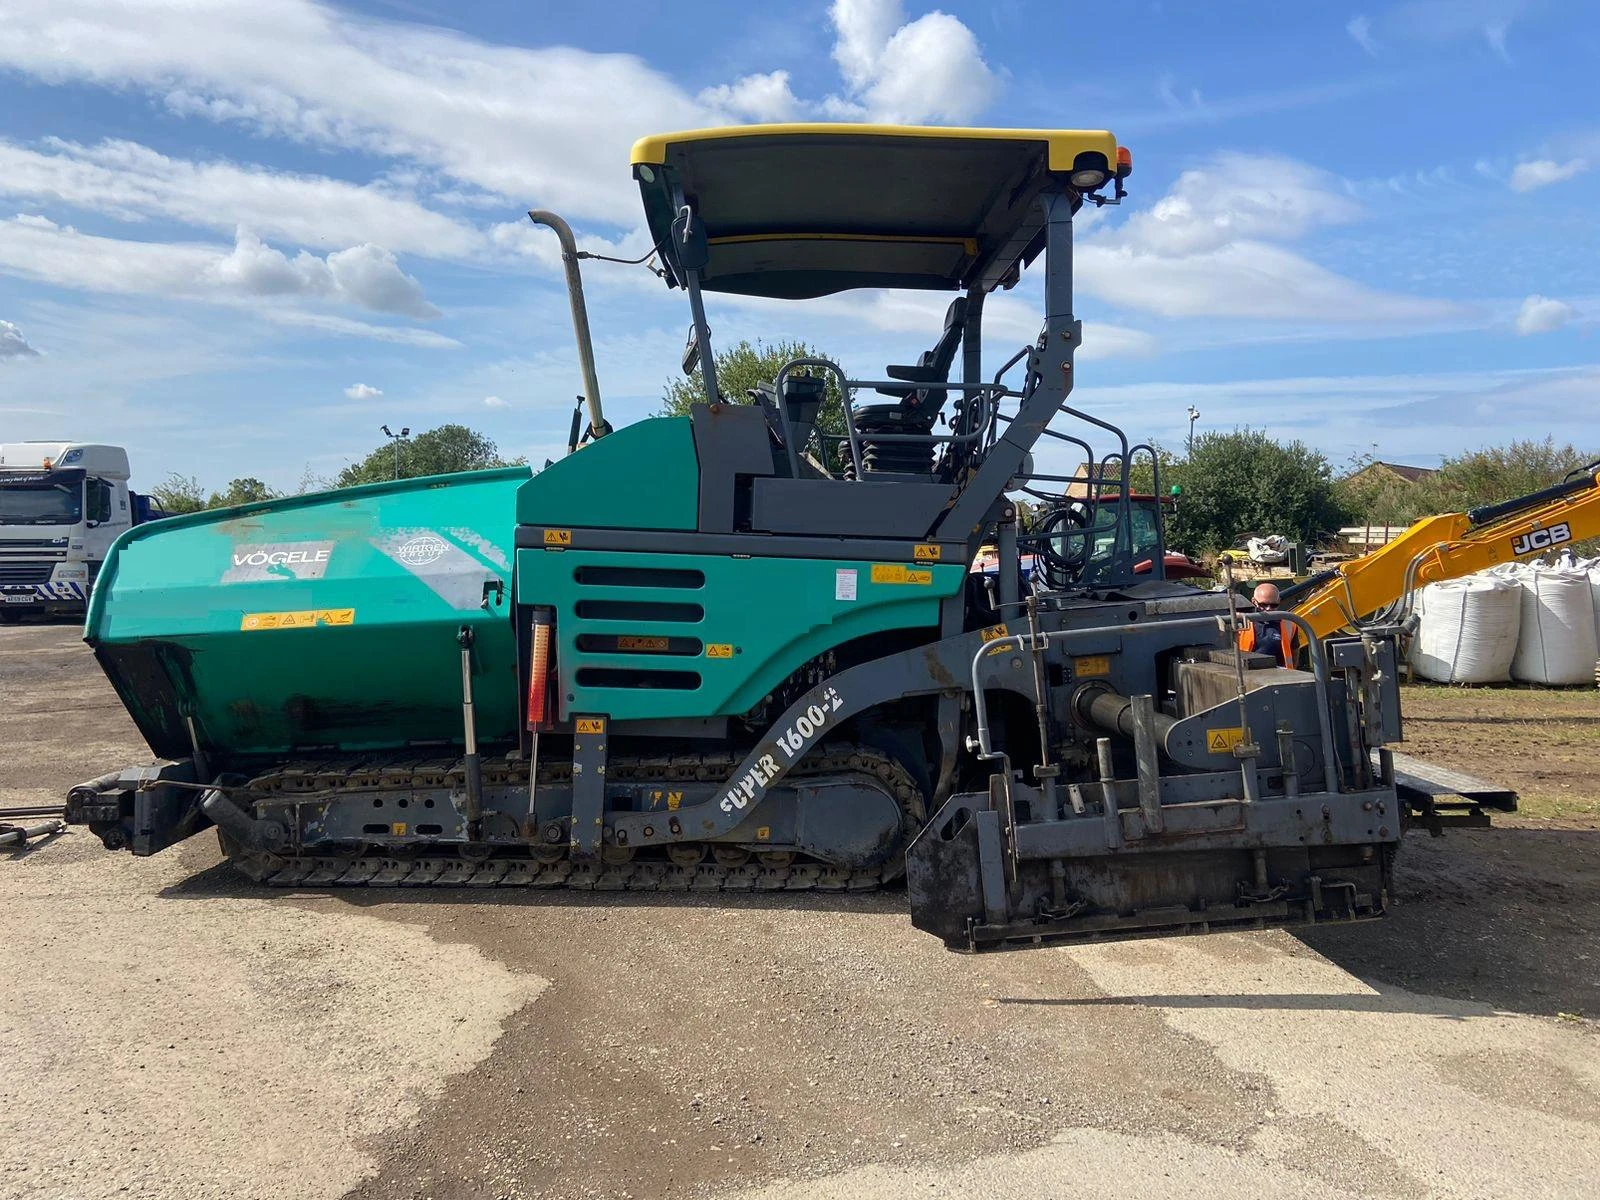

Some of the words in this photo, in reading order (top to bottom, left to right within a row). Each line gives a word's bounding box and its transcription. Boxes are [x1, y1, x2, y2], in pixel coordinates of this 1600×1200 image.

[398, 544, 449, 552] WIRTGEN
[1514, 524, 1570, 553] JCB
[234, 551, 330, 566] VÖGELE
[720, 753, 780, 812] SUPER
[776, 687, 844, 758] 1600-2
